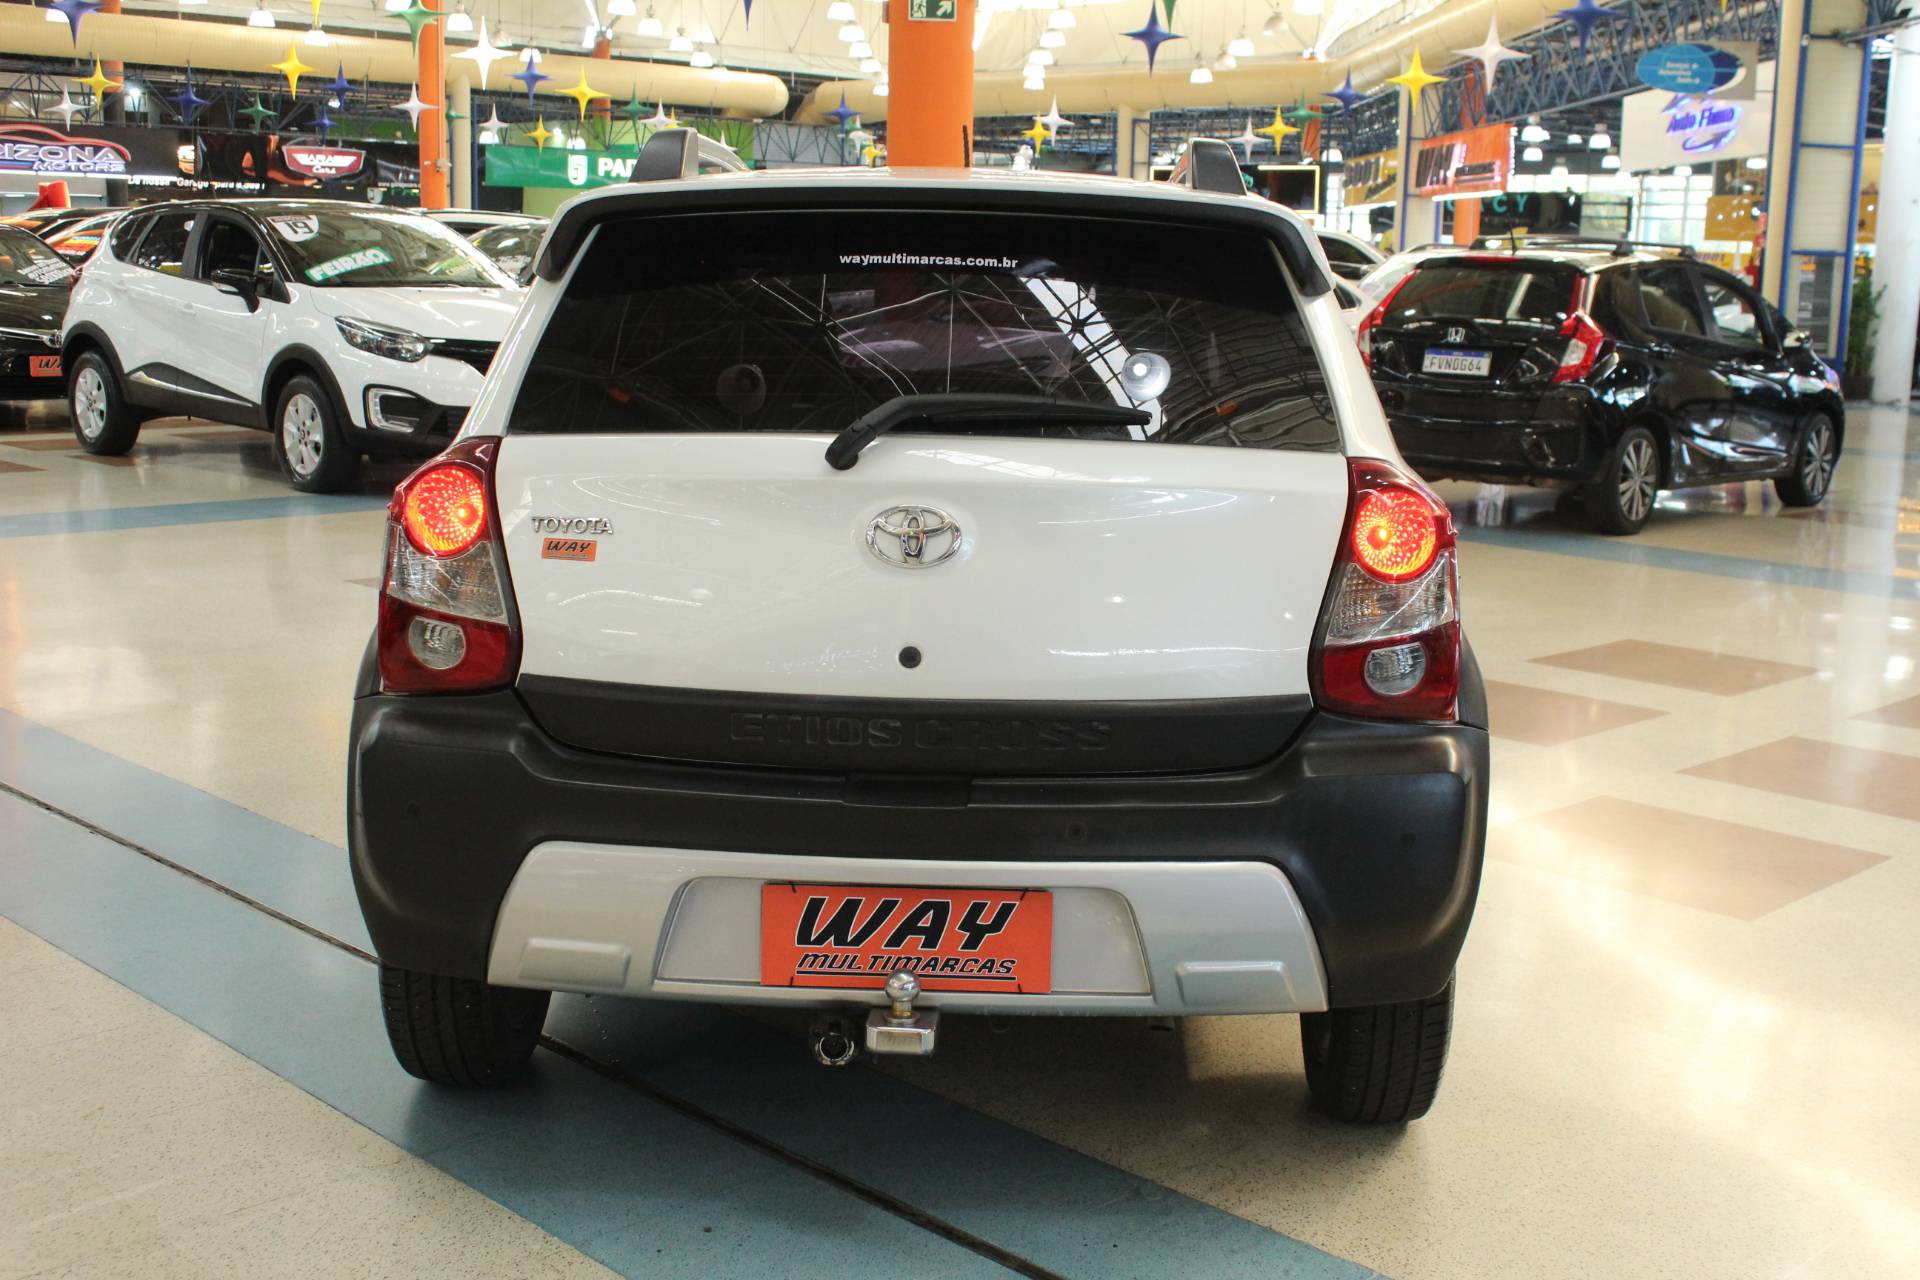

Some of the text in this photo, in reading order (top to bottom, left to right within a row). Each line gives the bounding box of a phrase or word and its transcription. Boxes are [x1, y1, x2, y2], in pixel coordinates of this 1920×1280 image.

[0, 143, 125, 163] IZONA
[32, 161, 127, 173] MOTORS
[839, 253, 1018, 268] waymultimarcas.com.br
[531, 515, 614, 535] TOYOTA
[546, 540, 591, 553] WAY
[729, 711, 1112, 751] ETIOS CROSS
[795, 895, 1020, 952] WAY
[796, 952, 1017, 975] MULTIMARCAS
